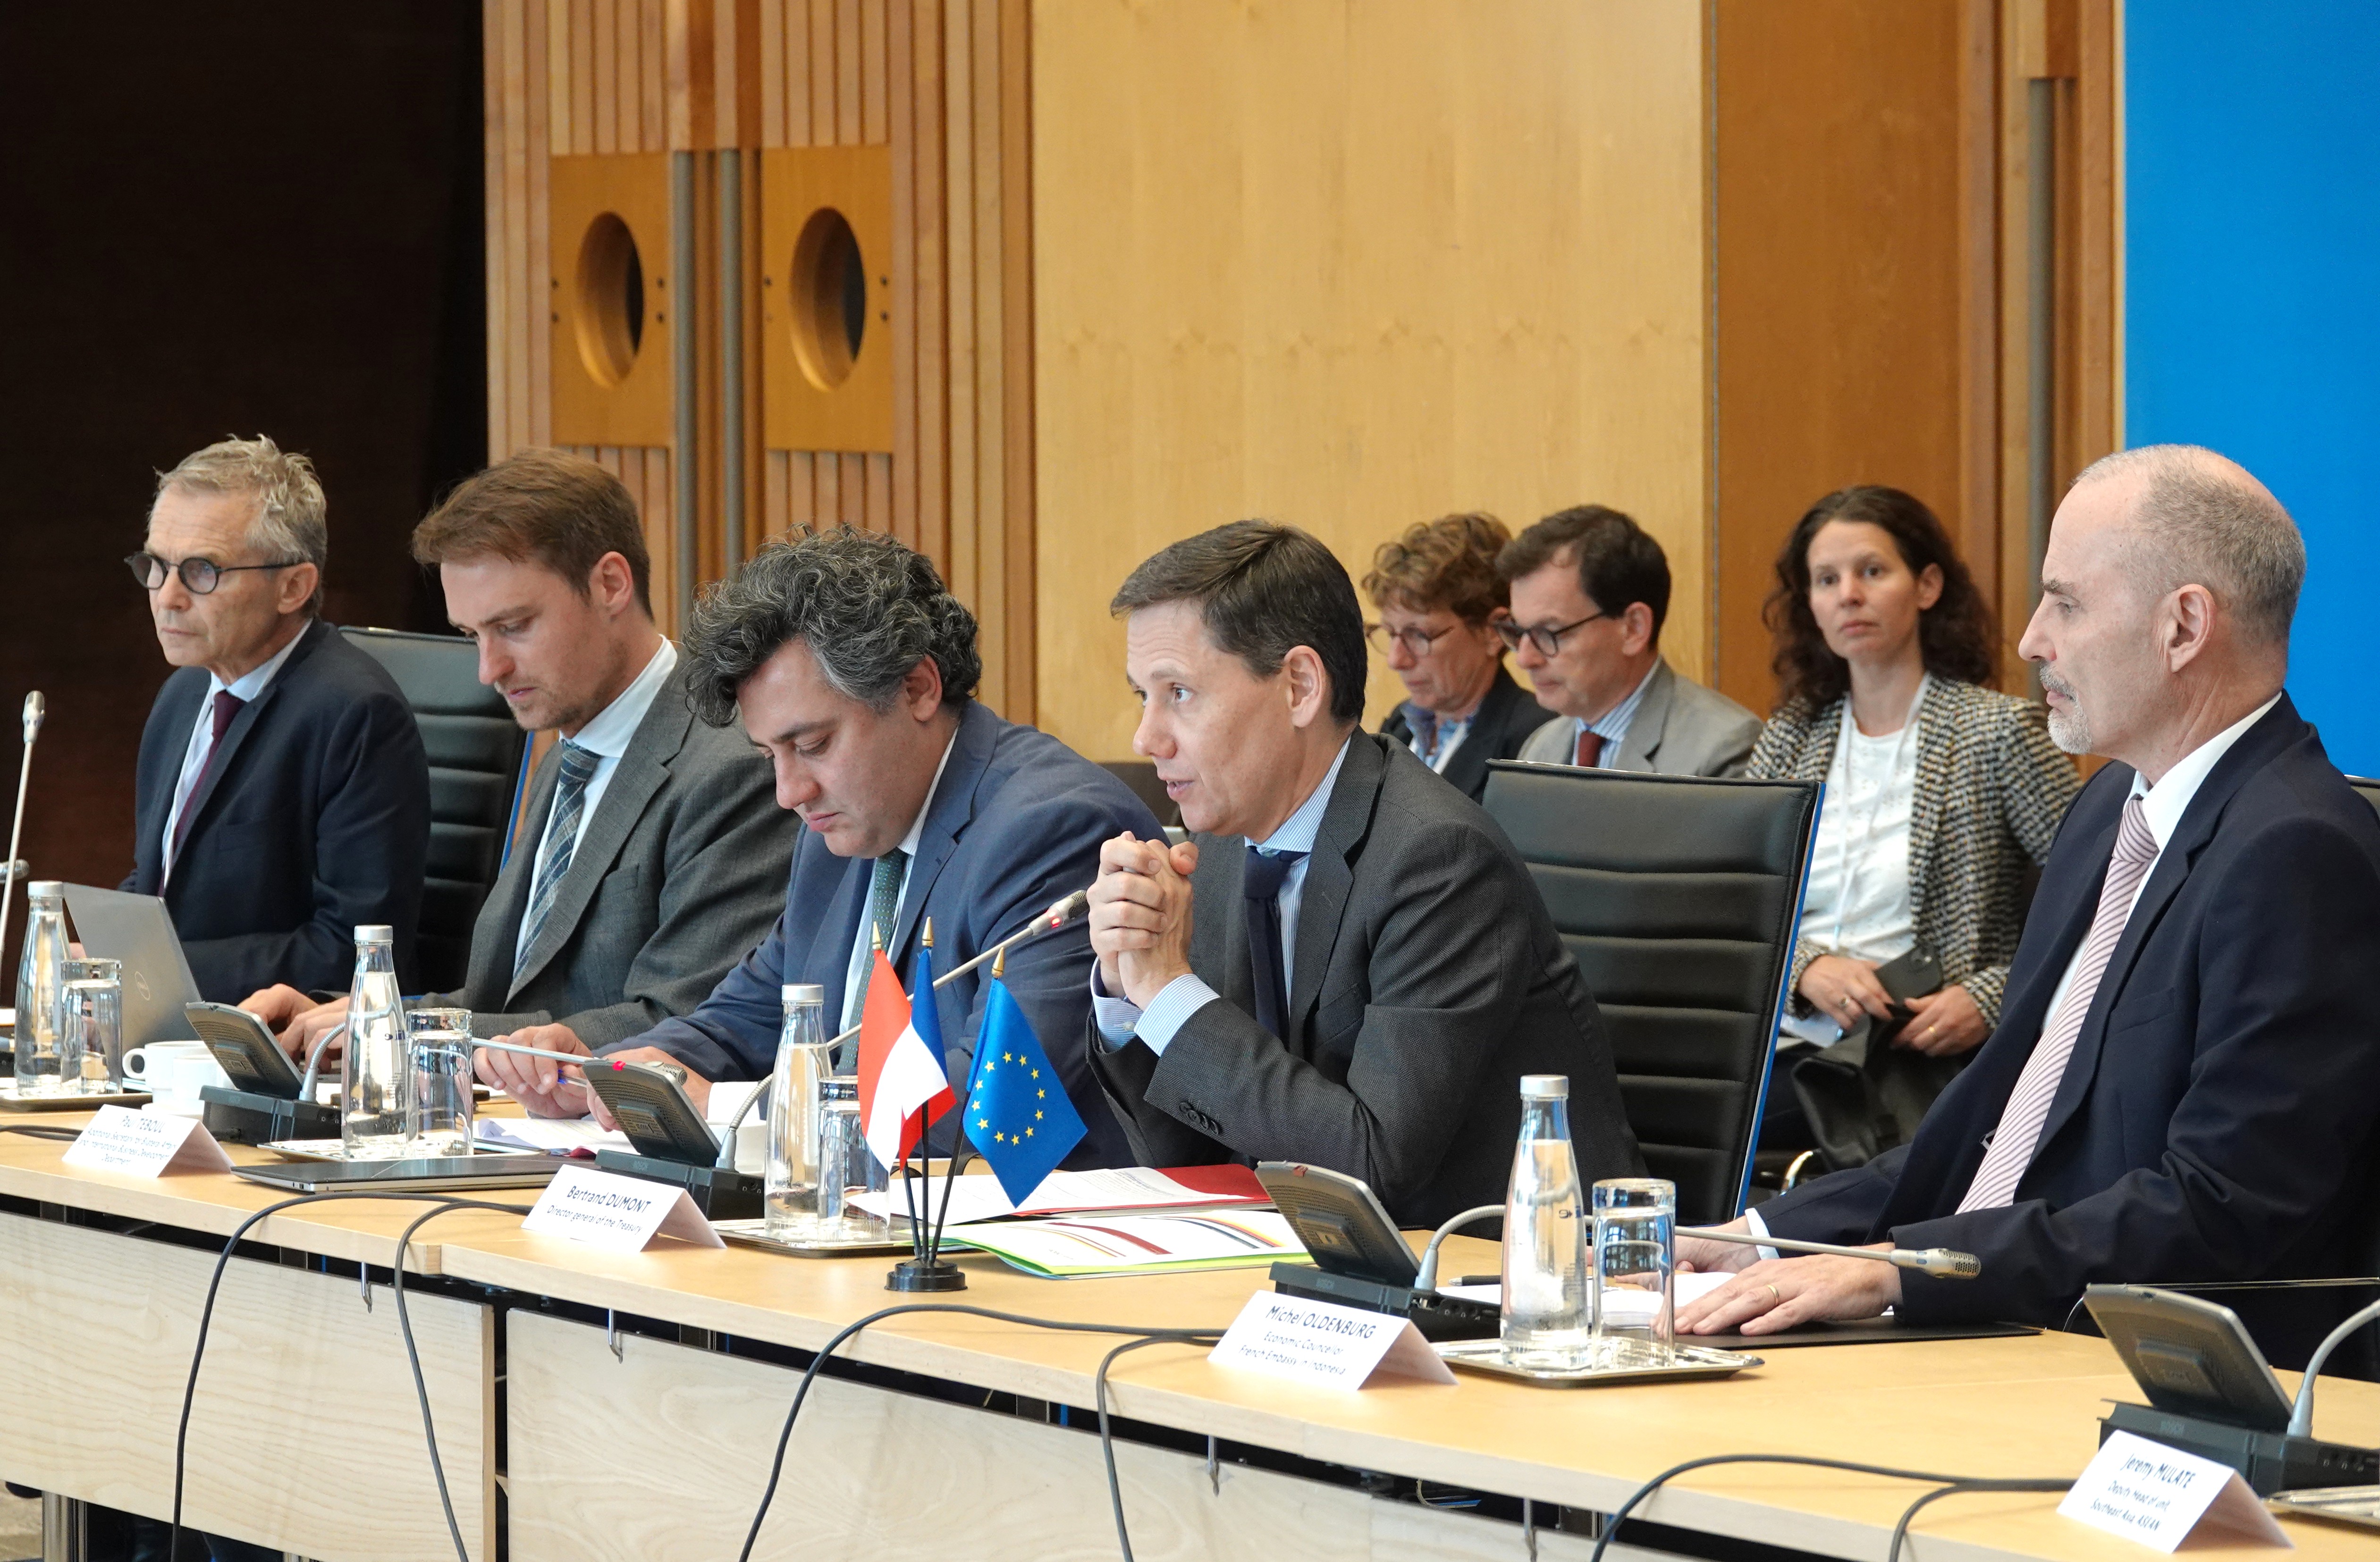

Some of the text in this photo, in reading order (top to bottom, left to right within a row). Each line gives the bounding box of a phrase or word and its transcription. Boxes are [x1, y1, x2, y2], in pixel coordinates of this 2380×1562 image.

[120, 1115, 166, 1133] Paul TEBOUL
[567, 1185, 651, 1213] Bertrand DUMONT
[547, 1205, 642, 1235] Director general of the Treasury
[1266, 1305, 1376, 1339] Michel OLDENBURG
[1264, 1331, 1301, 1347] Economic
[1238, 1345, 1346, 1375] French Embassy in Indonesia
[2119, 1453, 2196, 1488] Jeremy MULATE
[2108, 1480, 2131, 1498] Deputy
[2132, 1489, 2151, 1503] Head
[2148, 1495, 2160, 1505] of
[2090, 1498, 2123, 1518] Southeast
[2137, 1514, 2162, 1531] ASEAN
